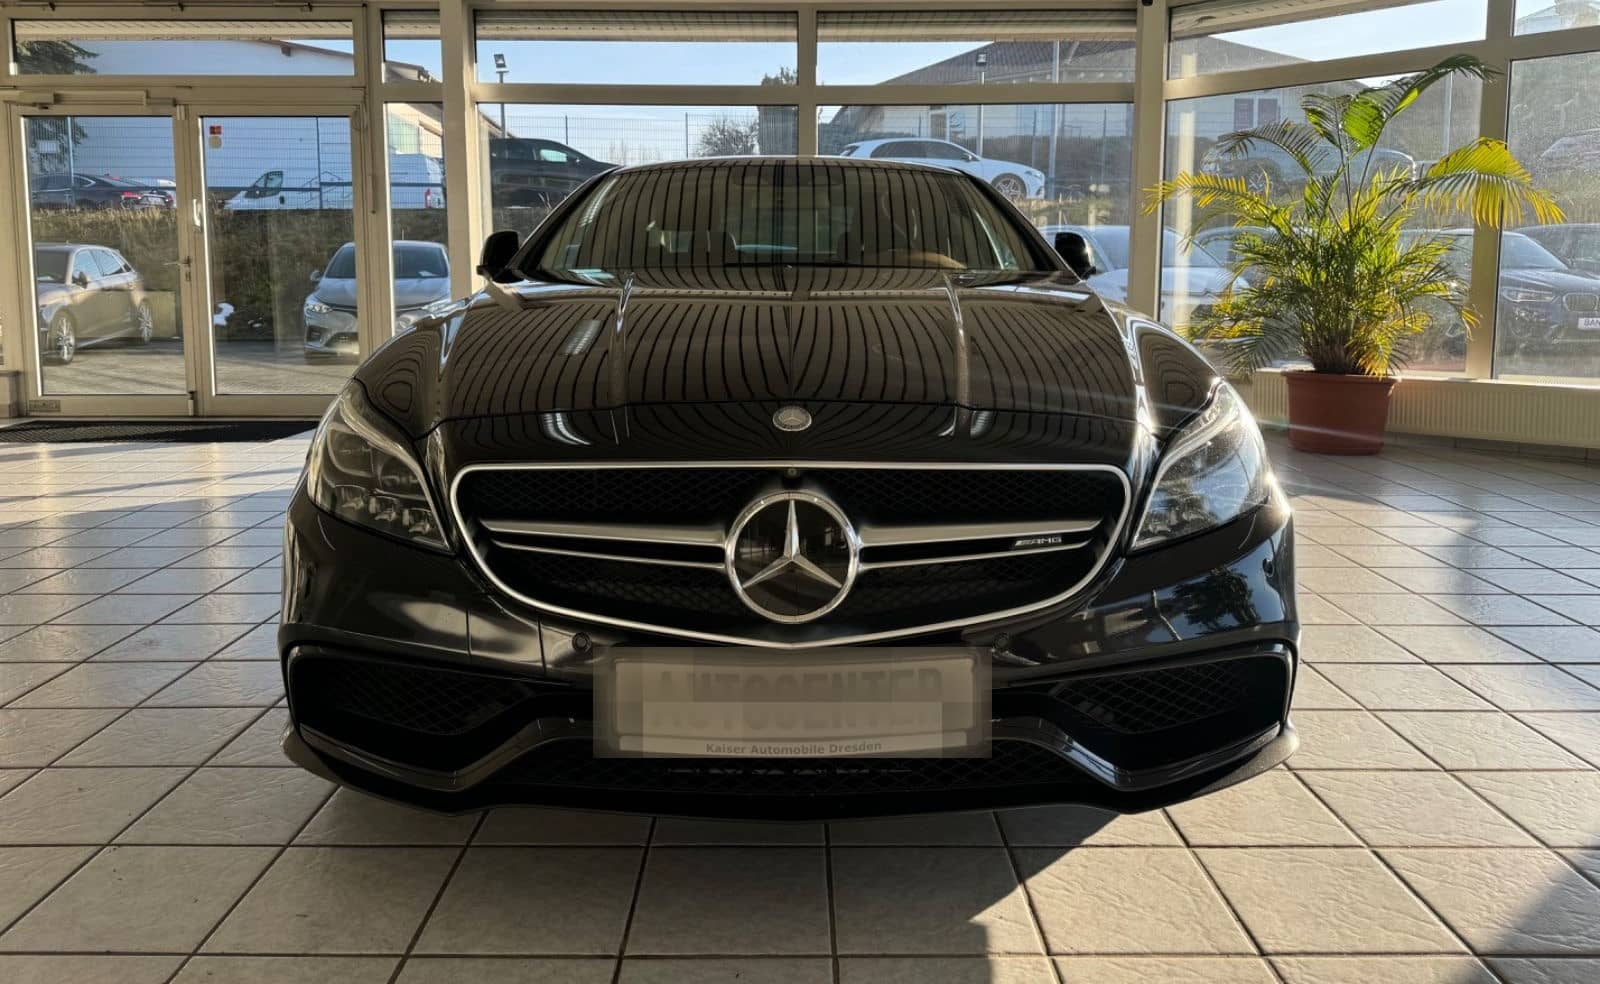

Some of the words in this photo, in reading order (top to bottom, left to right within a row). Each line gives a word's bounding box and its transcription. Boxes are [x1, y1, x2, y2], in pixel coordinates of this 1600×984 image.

[705, 743, 745, 754] Kaiser
[751, 743, 825, 755] Automobile
[829, 741, 882, 753] Dresden
